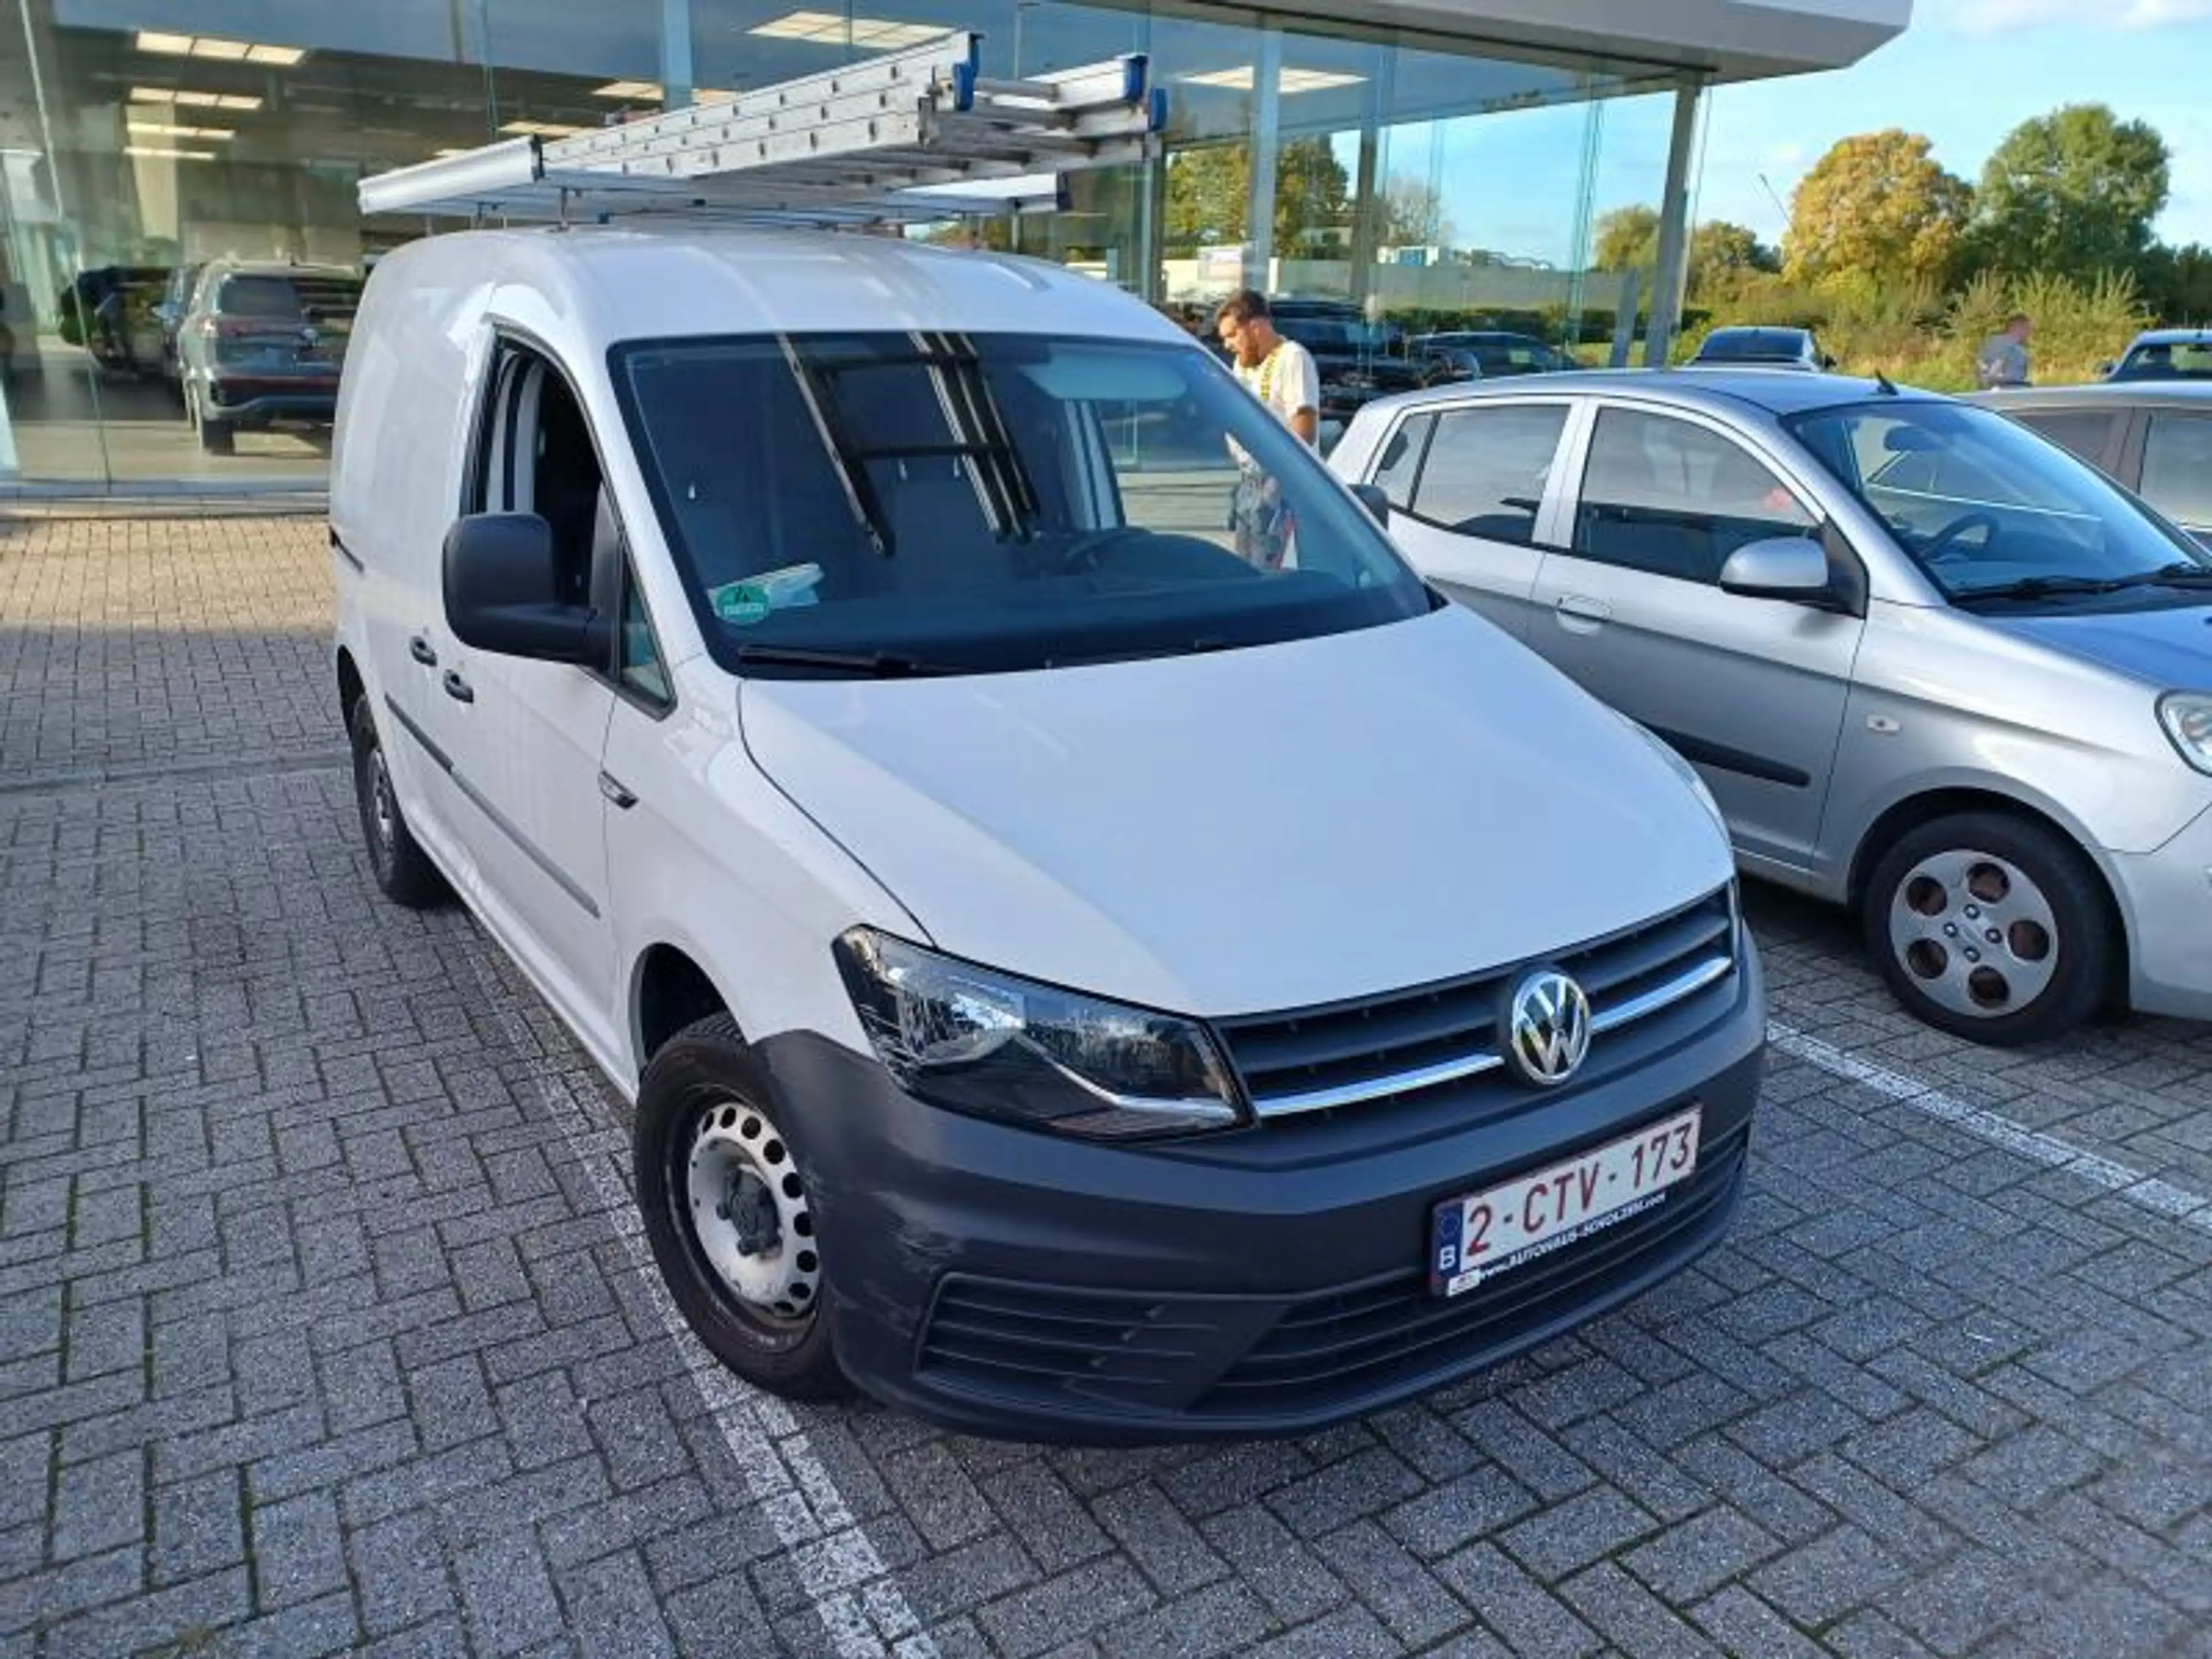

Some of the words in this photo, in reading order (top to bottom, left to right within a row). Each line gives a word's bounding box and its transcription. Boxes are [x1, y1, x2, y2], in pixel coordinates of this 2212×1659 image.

[1515, 976, 1588, 1080] VW
[1467, 1122, 1692, 1256] 2-CTV-173
[1440, 1244, 1456, 1270] B
